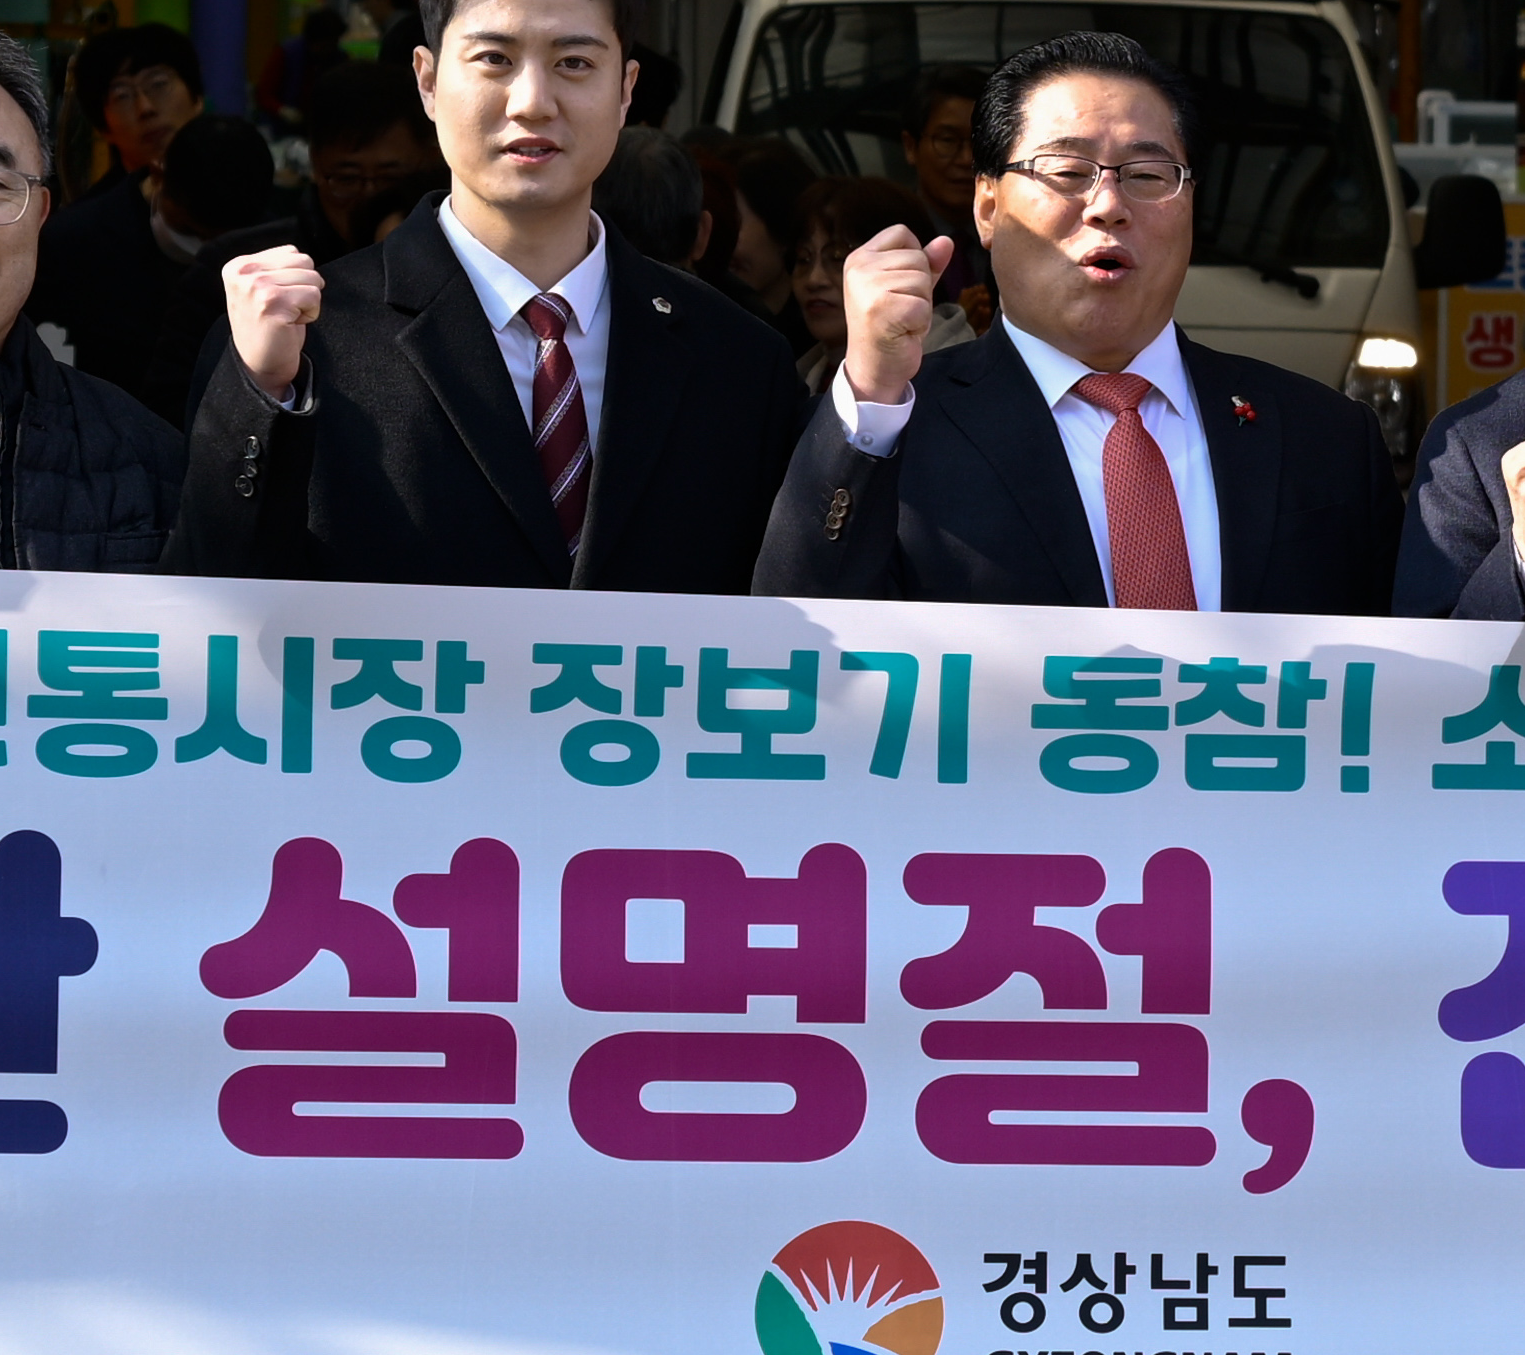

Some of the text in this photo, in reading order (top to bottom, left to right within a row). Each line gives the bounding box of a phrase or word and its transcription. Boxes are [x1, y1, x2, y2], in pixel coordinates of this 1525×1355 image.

[530, 642, 972, 787] 장보기
[1031, 655, 1376, 795] 동참!
[200, 837, 1314, 1194] 설명절,
[983, 1251, 1292, 1334] 경상남도
